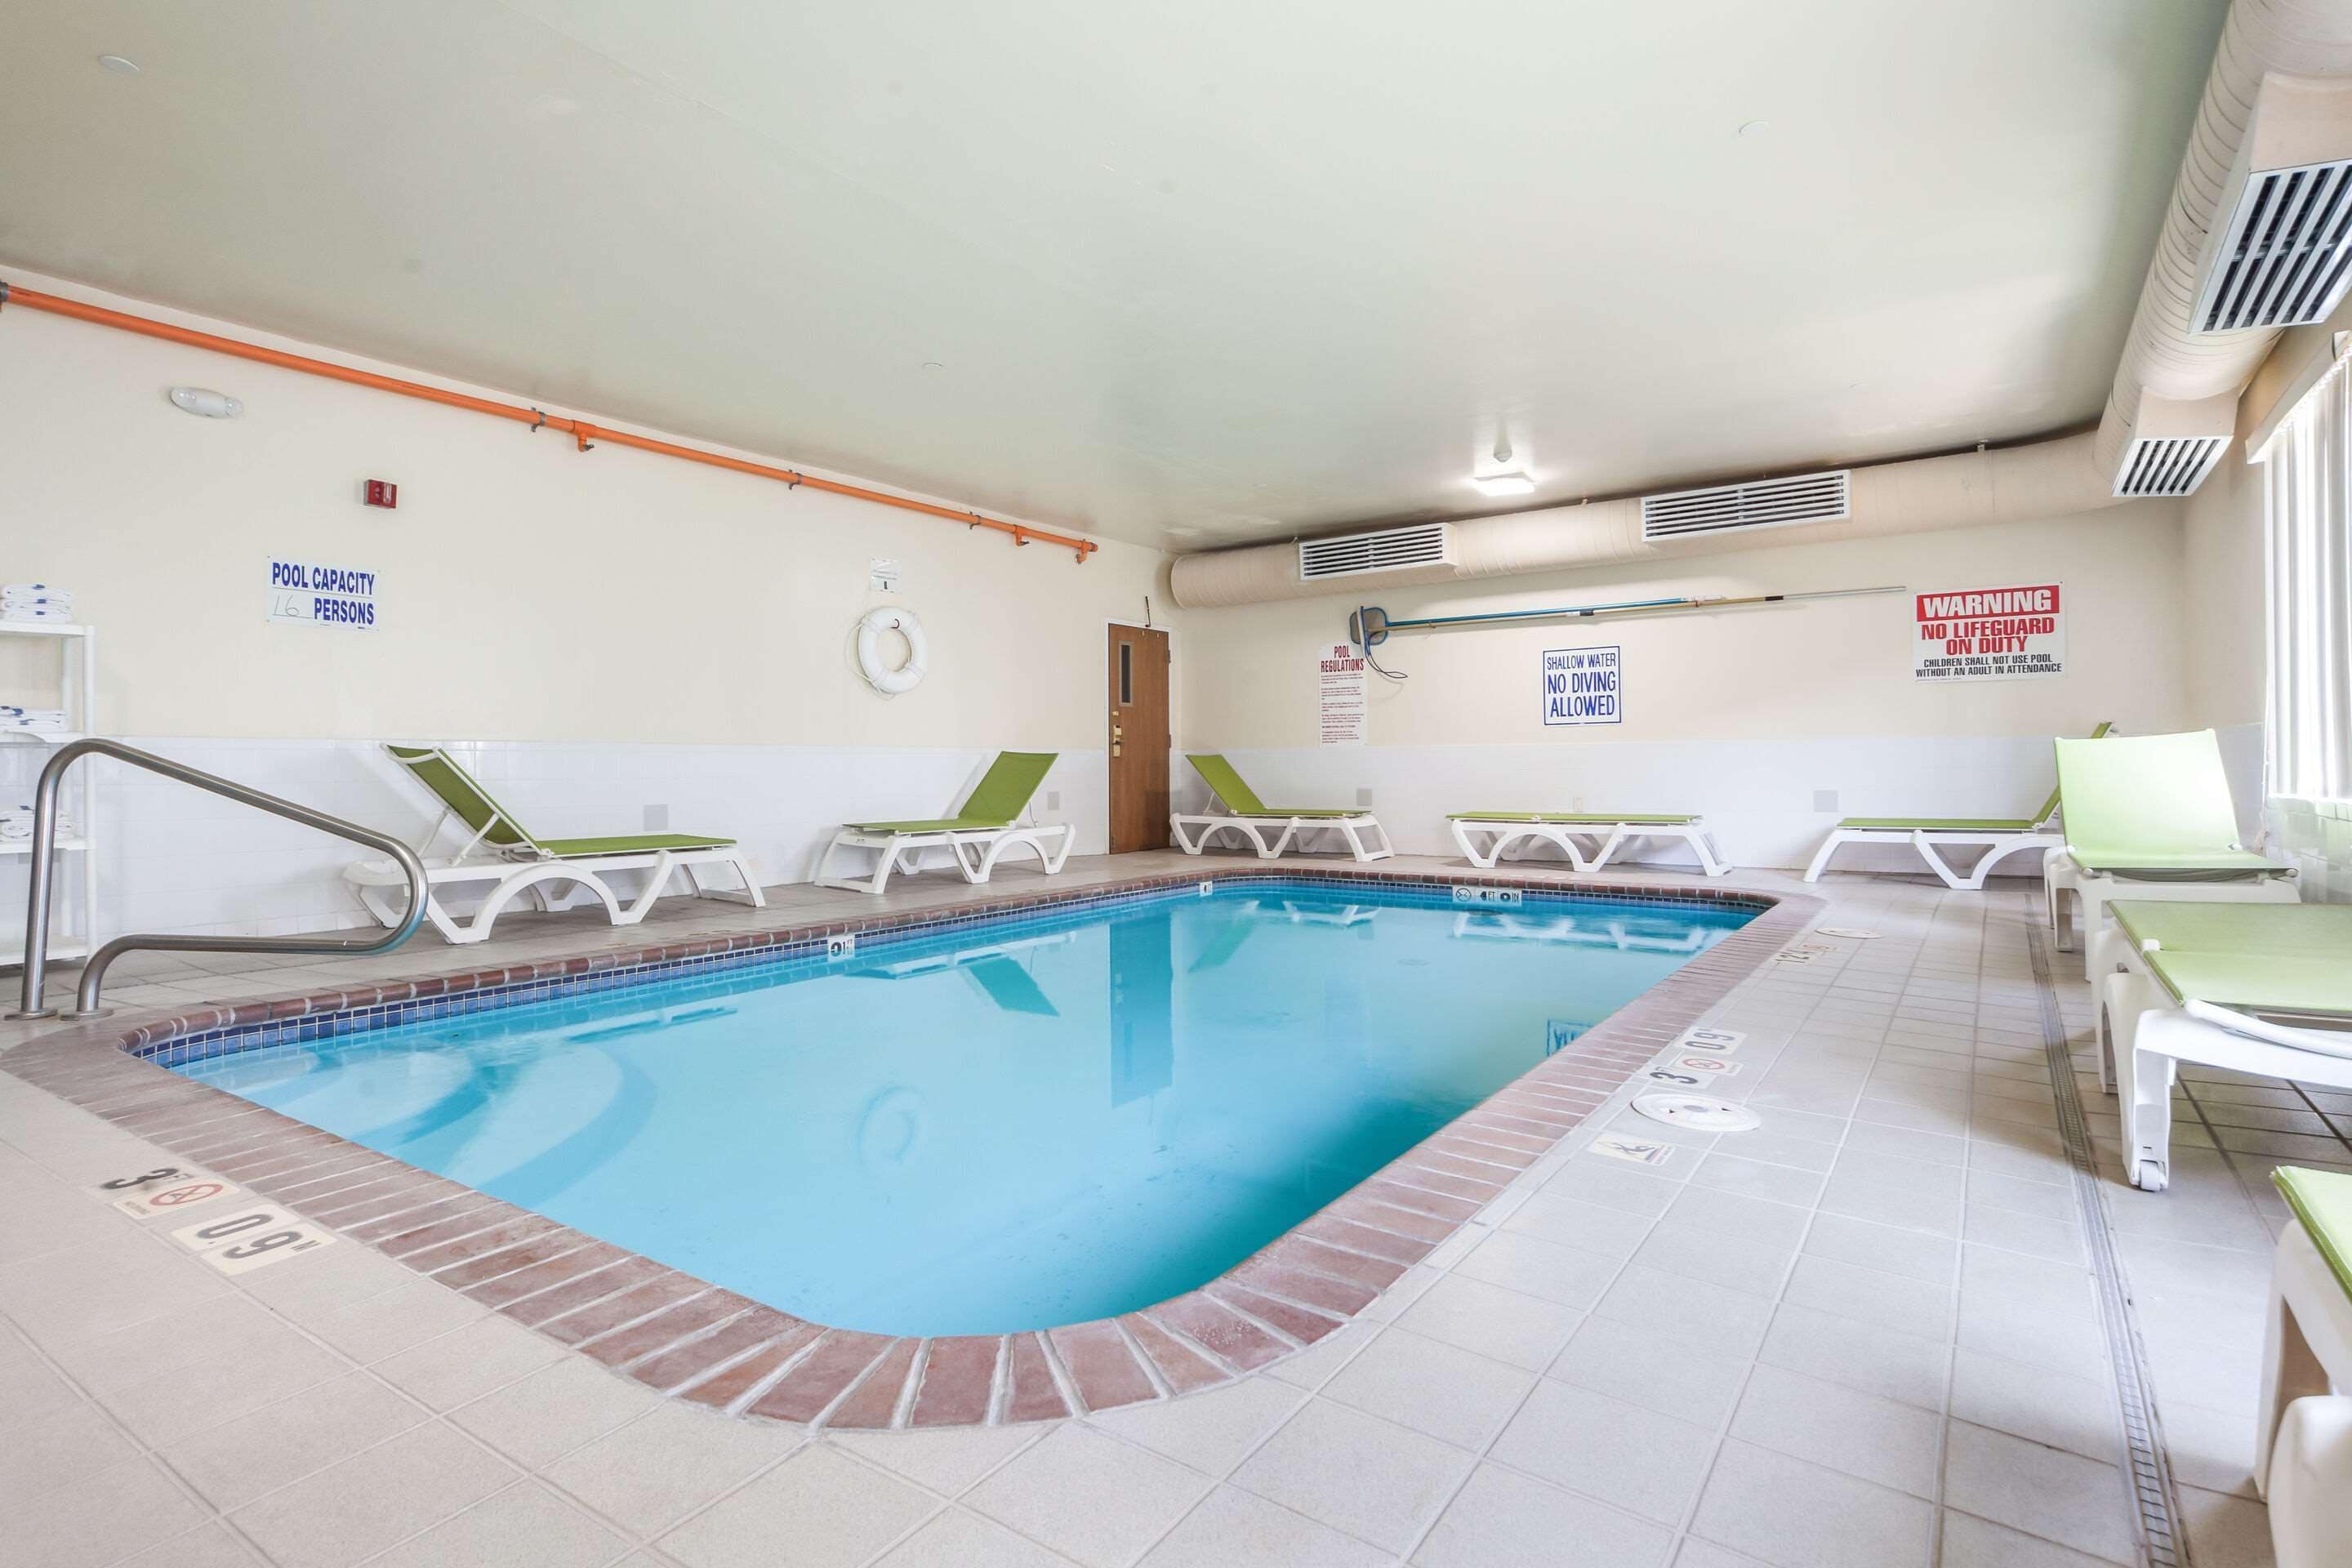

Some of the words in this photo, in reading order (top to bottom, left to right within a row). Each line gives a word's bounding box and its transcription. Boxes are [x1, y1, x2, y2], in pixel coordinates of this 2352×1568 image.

[273, 562, 308, 588] POOL
[312, 567, 375, 595] CAPACITY
[274, 595, 300, 617] 16
[314, 597, 374, 625] PERSONS
[1922, 589, 2051, 618] WARNING
[1922, 623, 1947, 640] NO
[1953, 617, 2055, 638] LIFEGUARD
[1334, 645, 1350, 658] POOL
[1946, 639, 1972, 655] ON
[1979, 636, 2028, 653] DUTY
[1321, 658, 1365, 673] REGULATIONS
[1547, 655, 1584, 670] SHALLOW
[1587, 653, 1616, 668] WATER
[1916, 667, 1950, 677] WITHOUT
[1953, 666, 1966, 676] AN
[1967, 666, 1992, 675] ADULT
[1995, 665, 2004, 675] IN
[2007, 663, 2062, 674] ATTENDANCE
[1923, 657, 1962, 668] CHILDREN
[1965, 656, 1989, 666] SHALL
[1993, 655, 2009, 666] NOT
[2012, 654, 2028, 665] USE
[2031, 653, 2052, 663] POOL
[1548, 674, 1566, 694] NO
[1572, 670, 1616, 693] DIVING
[1550, 695, 1615, 718] ALLOWED
